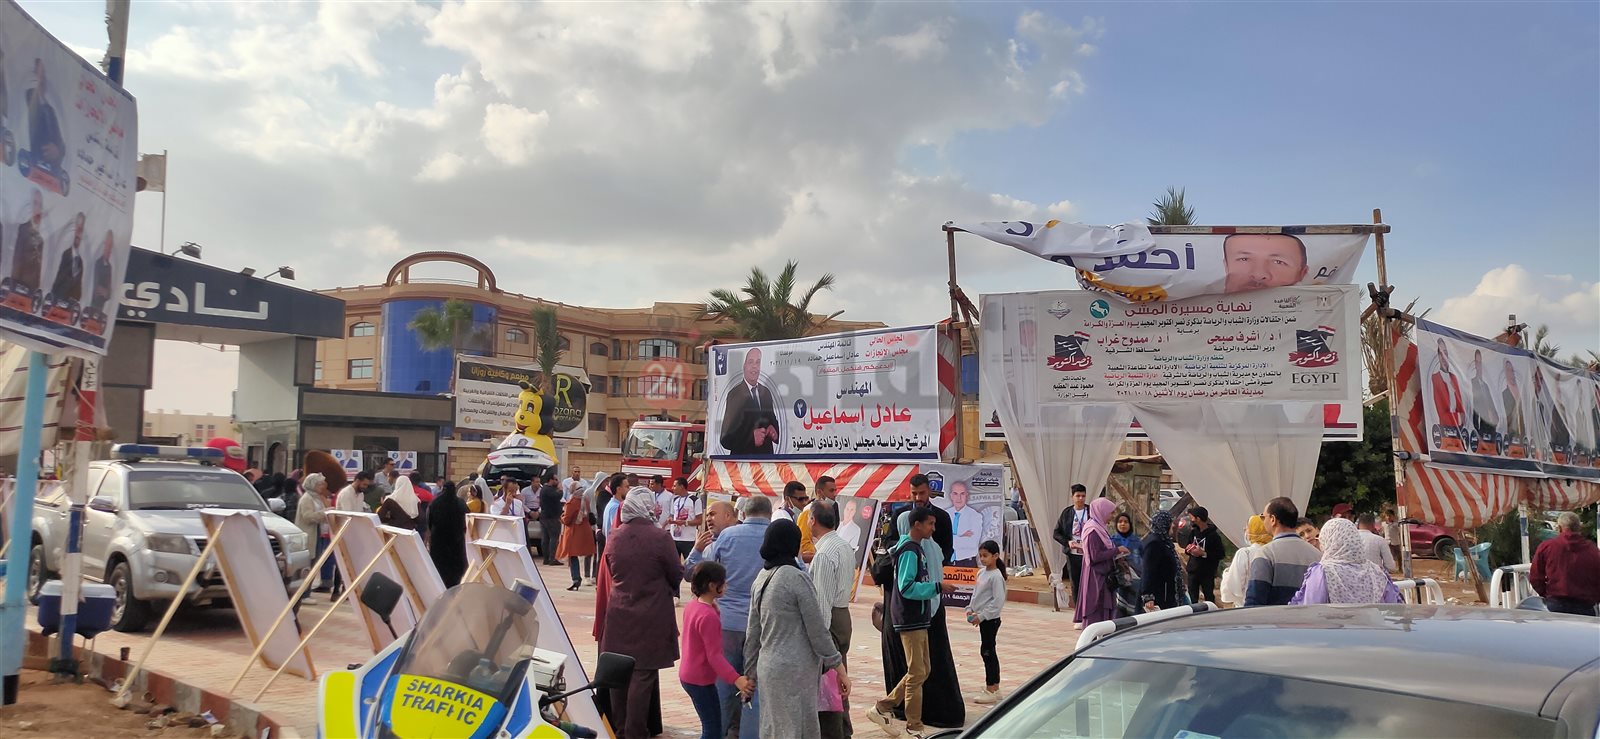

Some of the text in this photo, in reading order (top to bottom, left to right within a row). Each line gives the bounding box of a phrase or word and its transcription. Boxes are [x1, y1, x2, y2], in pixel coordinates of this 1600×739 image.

[118, 282, 268, 320] نادي
[1170, 303, 1213, 316] مسيرة
[1216, 301, 1252, 315] نهاية
[1083, 320, 1108, 328] والكرامة
[1109, 320, 1126, 328] العزة
[1140, 320, 1157, 328] المجيد
[1174, 319, 1185, 328] نصر
[1203, 317, 1227, 326] والرياضة
[1228, 316, 1246, 326] الشباب
[1246, 317, 1260, 326] وزارة
[887, 334, 905, 345] المجلس
[1097, 334, 1120, 346] غراب
[1122, 335, 1148, 346] ممدوح
[1235, 331, 1260, 343] أشرف
[817, 342, 836, 352] المهندس
[1213, 345, 1240, 353] والرياضة
[1262, 345, 1275, 353] وزير
[846, 350, 860, 361] عادل
[892, 348, 909, 359] مجلس
[1318, 352, 1336, 363] نصر
[1074, 356, 1090, 367] نصر
[1213, 371, 1231, 379] الشباب
[1292, 372, 1340, 384] EGYPT
[1257, 379, 1273, 387] مسيرة
[836, 381, 873, 399] المهندس
[1176, 390, 1189, 398] يوم
[1188, 389, 1208, 398] رمضان
[1210, 389, 1218, 397] من
[1219, 388, 1240, 397] العاشر
[1241, 388, 1264, 397] بمدينة
[803, 402, 866, 431] إسماعيل
[871, 402, 912, 428] عادل
[792, 436, 817, 452] الصفوة
[853, 436, 876, 452] مجلس
[877, 434, 904, 451] لرئاسة
[905, 433, 931, 452] المرشح
[952, 593, 970, 601] الجمعة
[407, 678, 484, 711] SHARKIA
